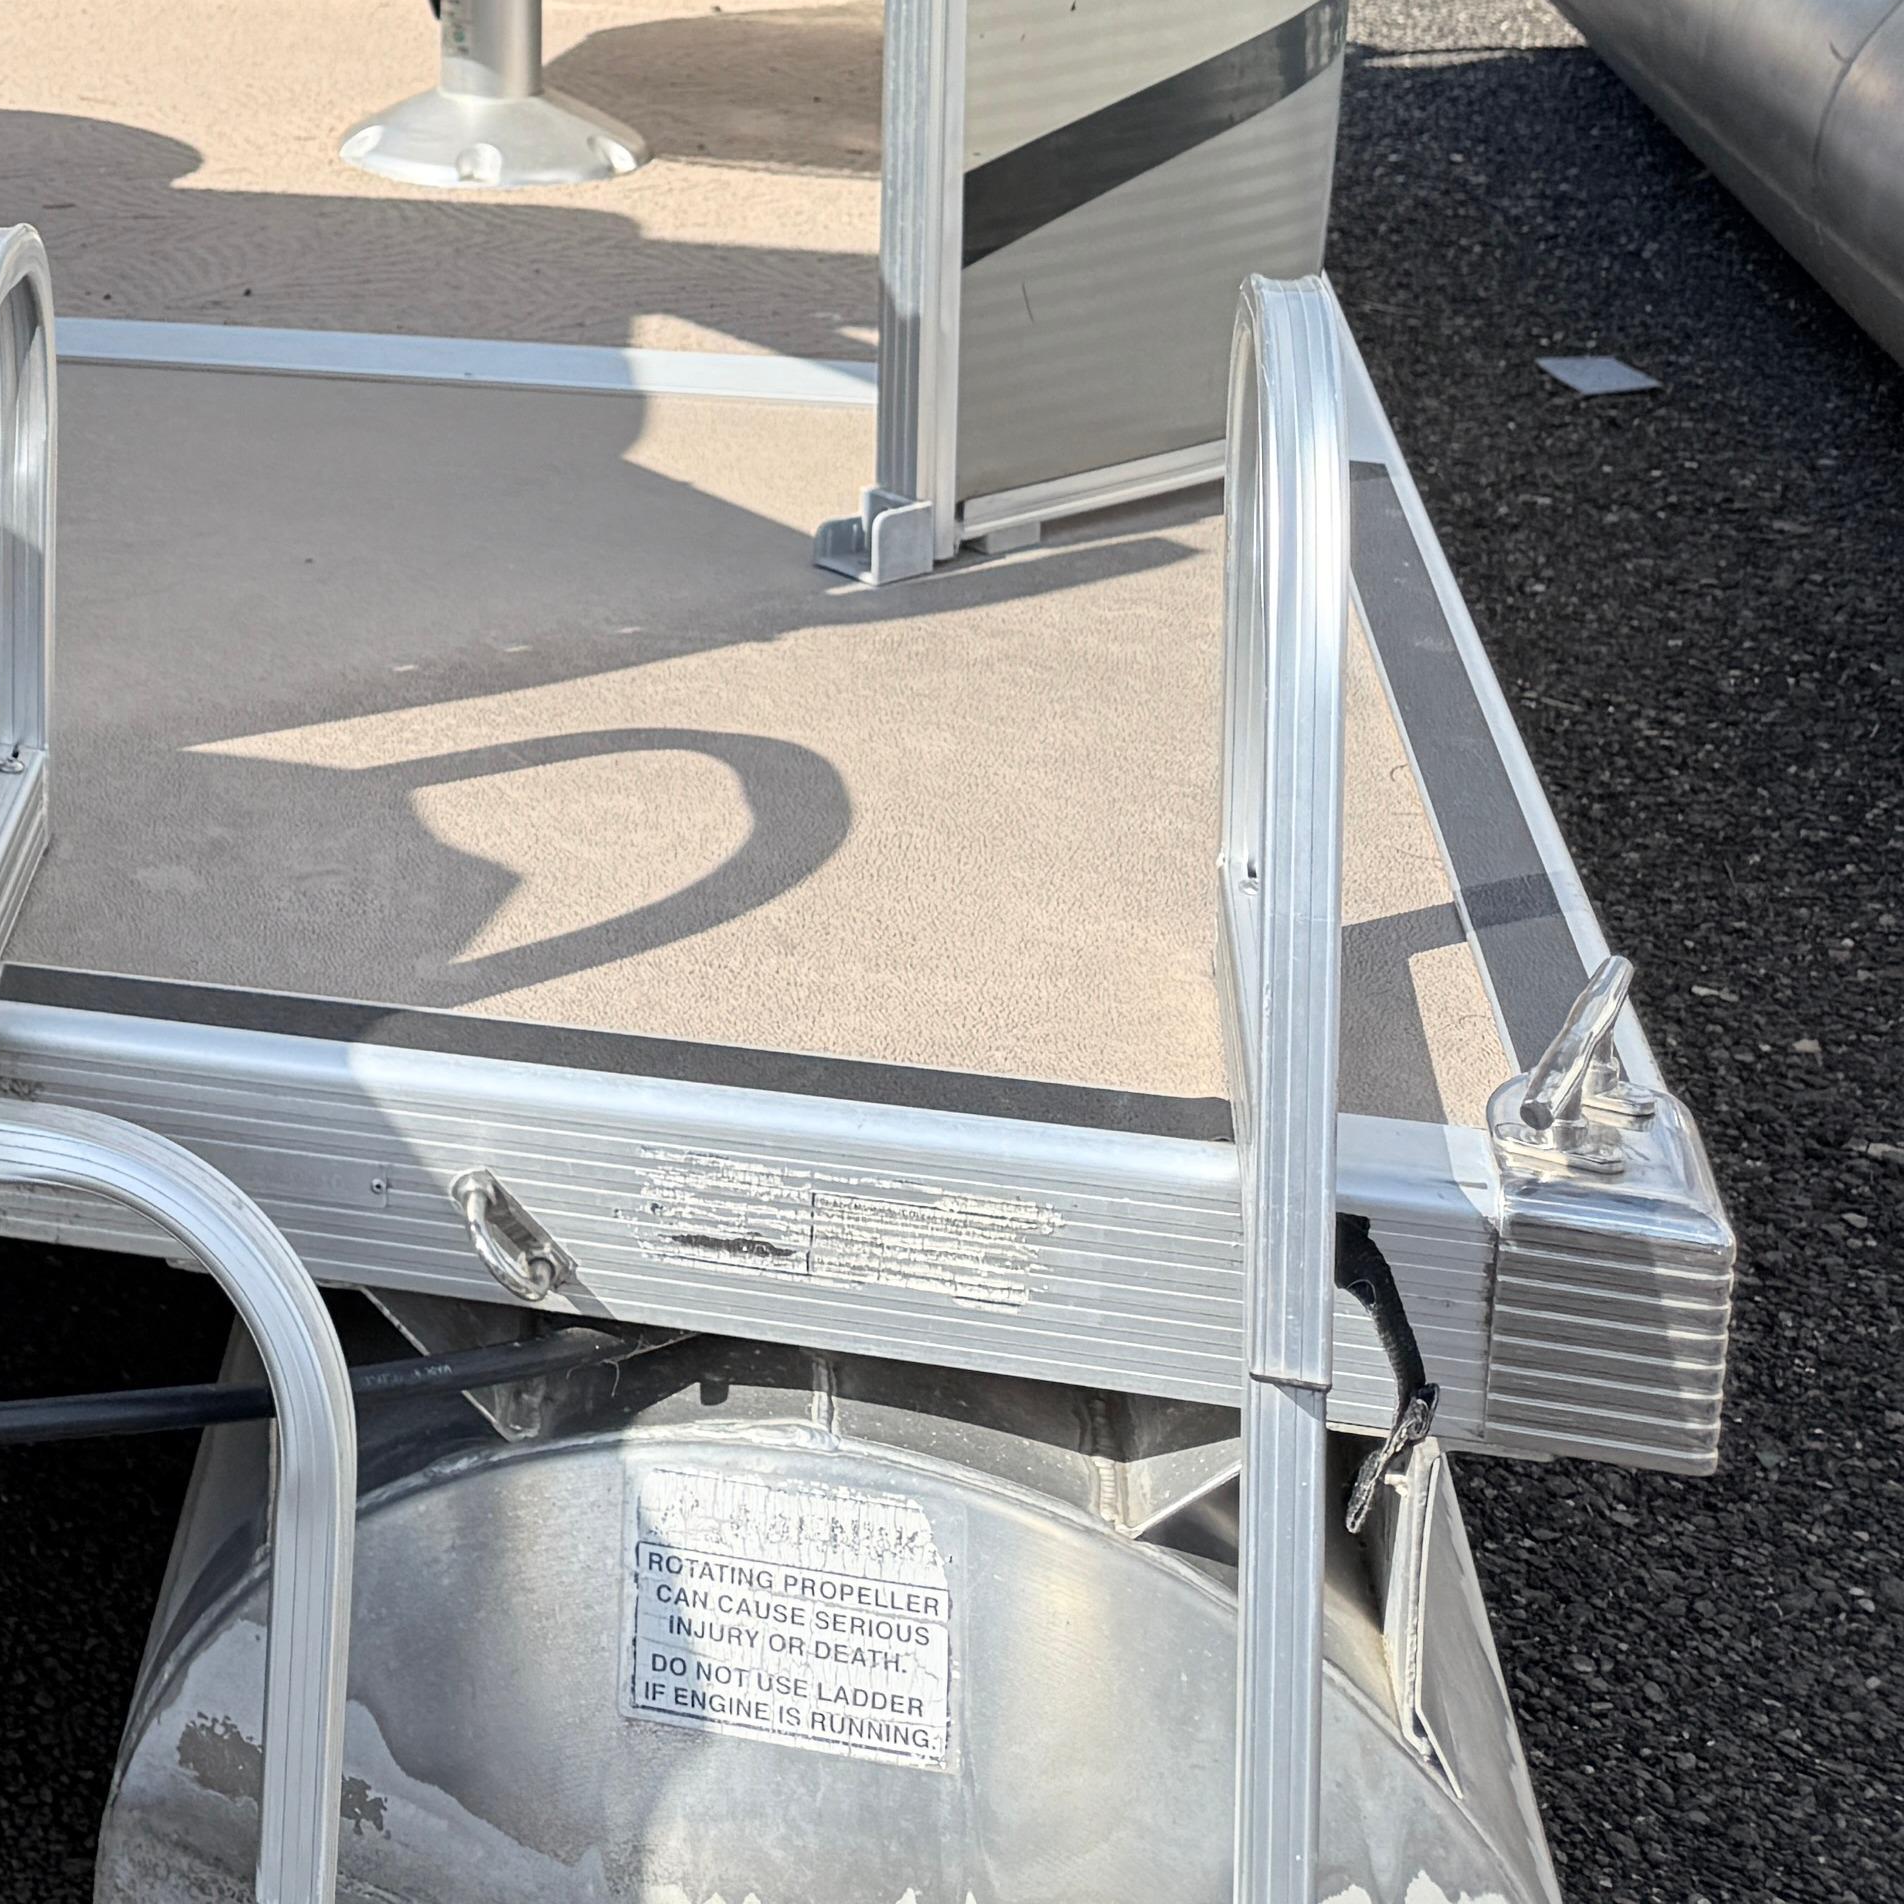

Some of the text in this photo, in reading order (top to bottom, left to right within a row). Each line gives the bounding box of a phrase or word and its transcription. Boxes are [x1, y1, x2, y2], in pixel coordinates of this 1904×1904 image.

[648, 1552, 940, 1617] ROTATING PROPELLER
[656, 1584, 931, 1647] CAN CAUSE SERIOUS
[668, 1614, 909, 1675] INJURY OR DEATH.
[644, 1681, 938, 1751] IF ENGINE IS RUNNING.
[651, 1653, 925, 1719] DO NOT USE LADDER
